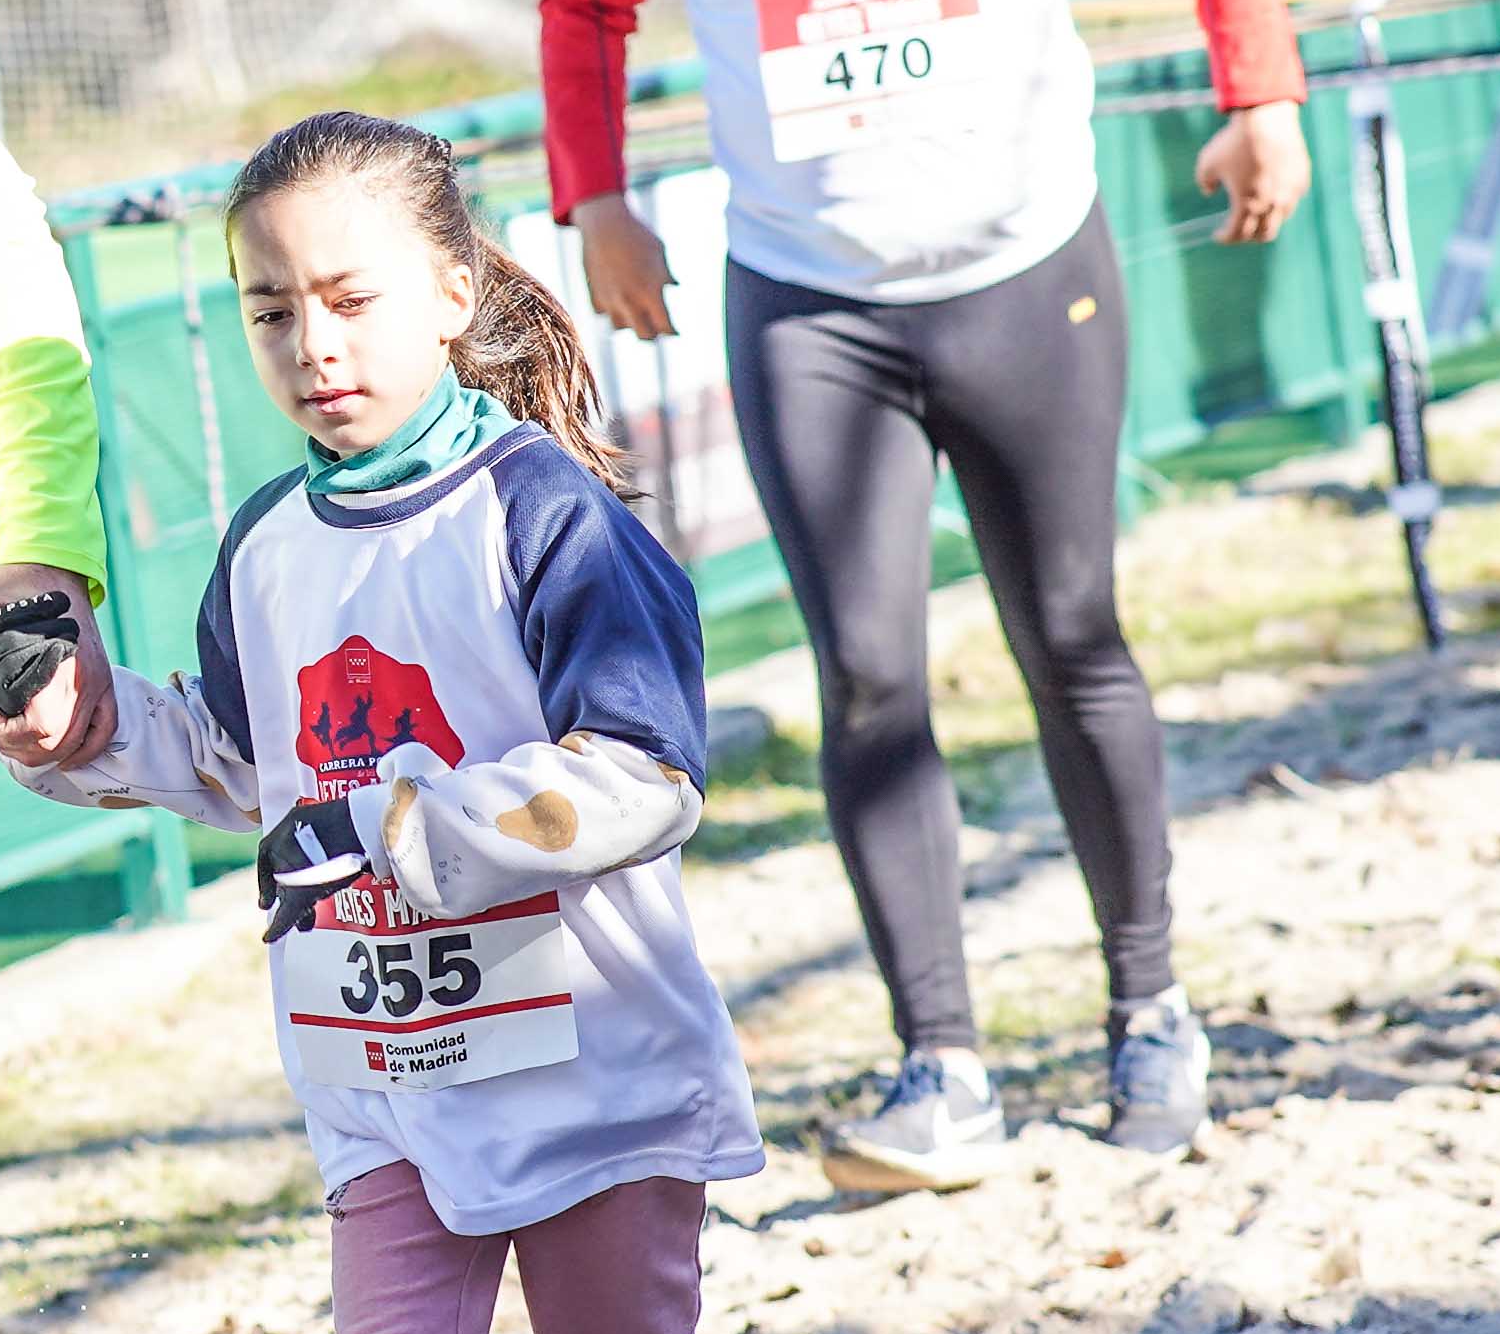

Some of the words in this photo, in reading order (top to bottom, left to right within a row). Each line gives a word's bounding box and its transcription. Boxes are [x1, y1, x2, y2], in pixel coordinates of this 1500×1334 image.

[824, 37, 933, 92] 470
[340, 932, 482, 1018] 355
[385, 1031, 466, 1056] Comunidad
[389, 1059, 405, 1073] de
[409, 1048, 468, 1073] Madrid
